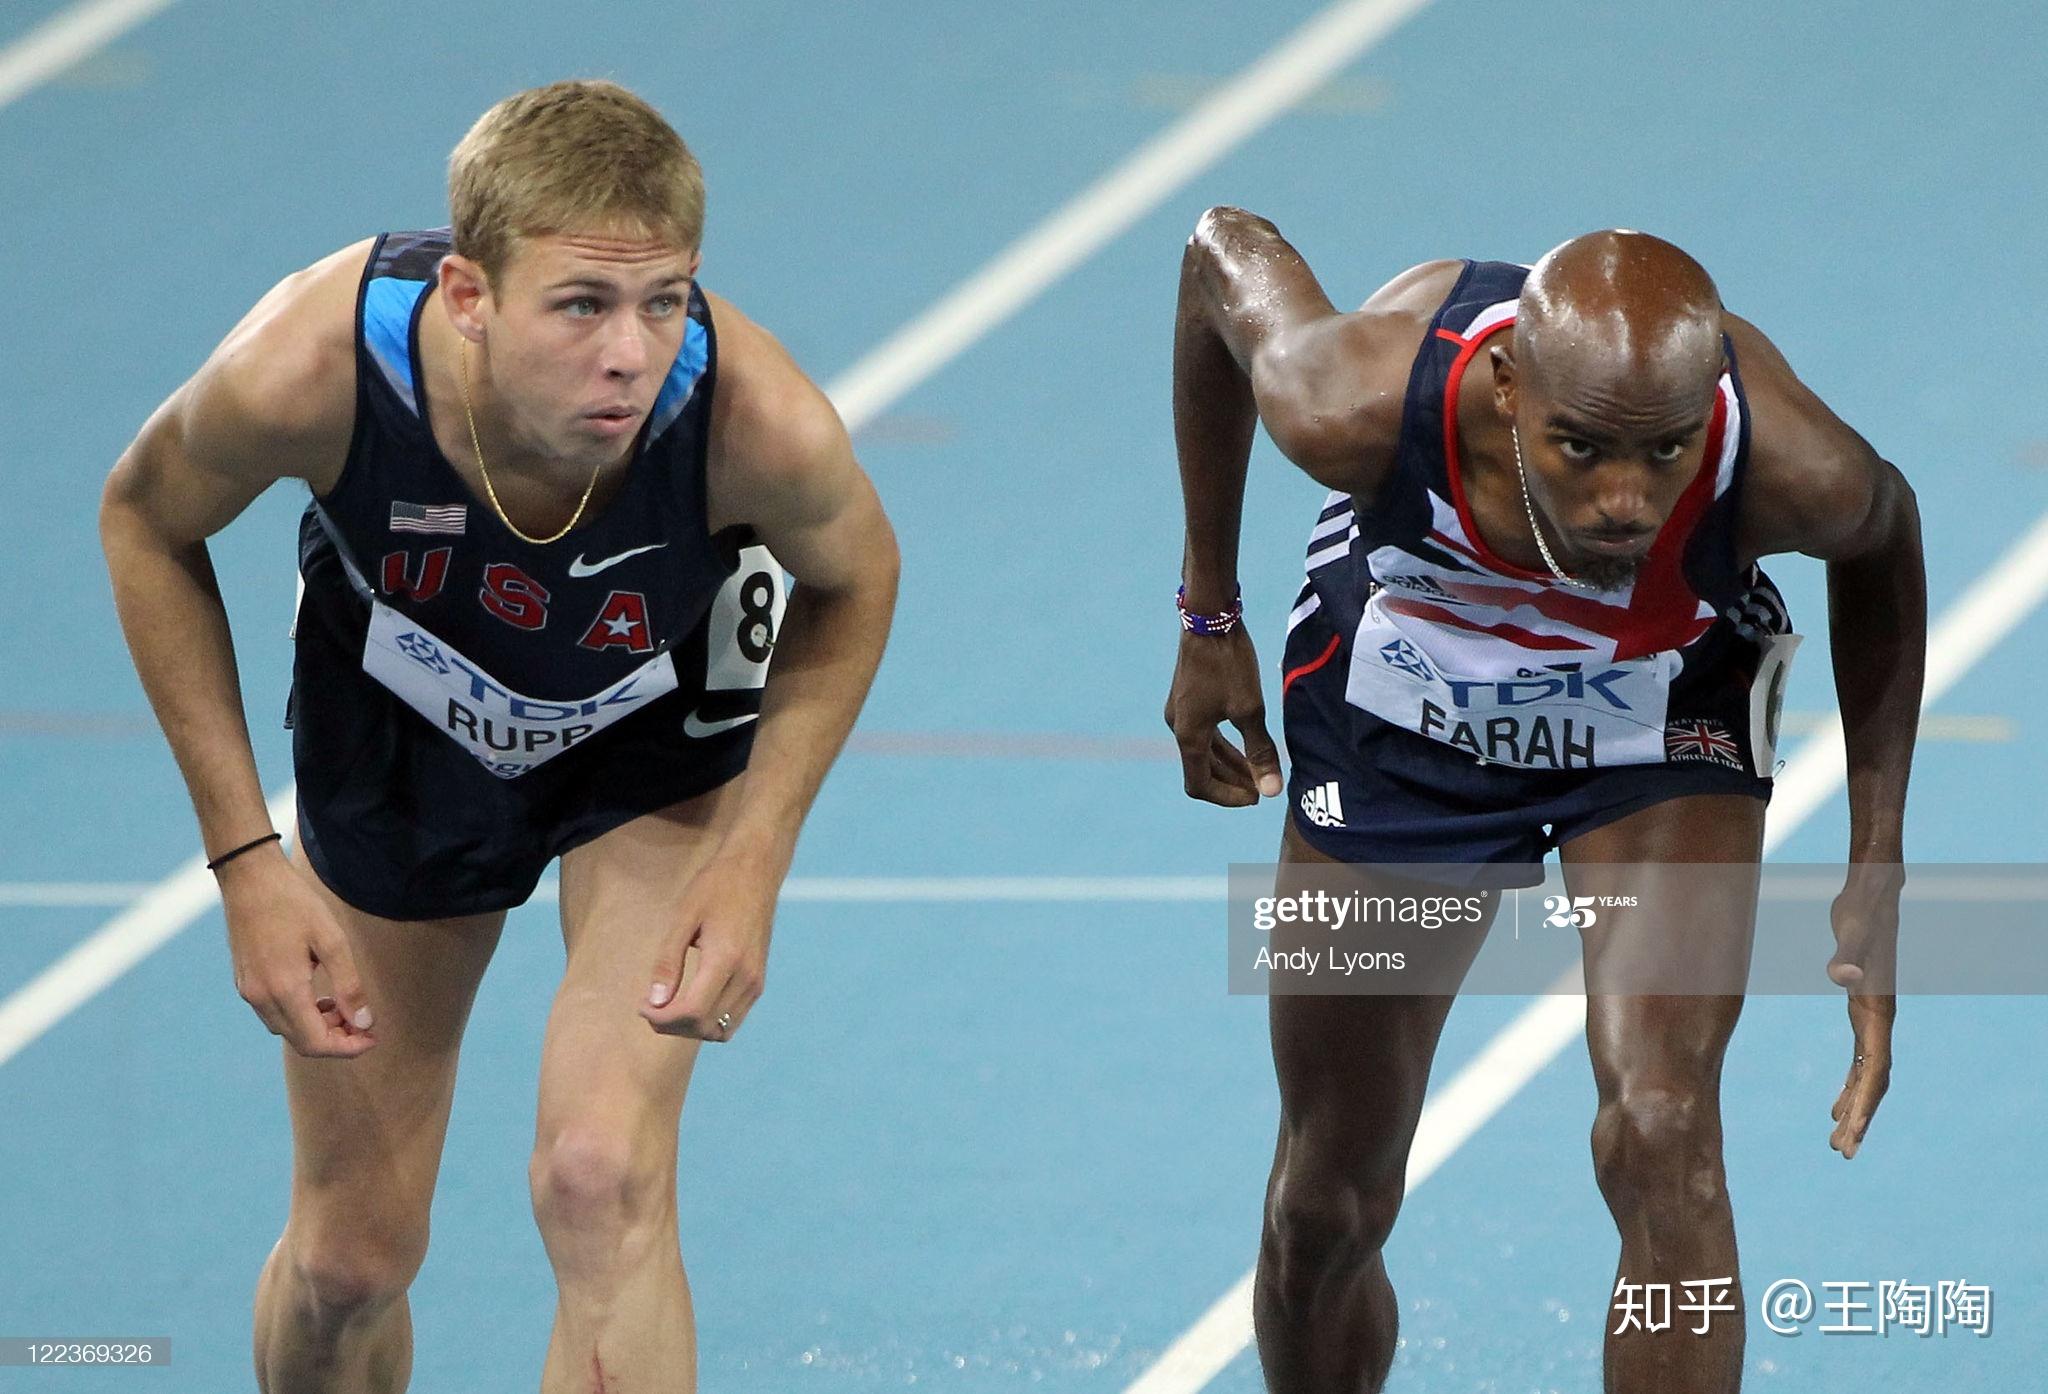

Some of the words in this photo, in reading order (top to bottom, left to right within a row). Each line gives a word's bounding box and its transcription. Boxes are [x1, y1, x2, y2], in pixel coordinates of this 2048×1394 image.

[381, 547, 654, 653] USA
[737, 571, 775, 663] 8
[450, 657, 642, 721] TDK
[1447, 669, 1633, 711] TDK
[447, 697, 594, 752] RUPP
[1420, 698, 1595, 768] FARAH
[1719, 758, 1744, 773] TEAM
